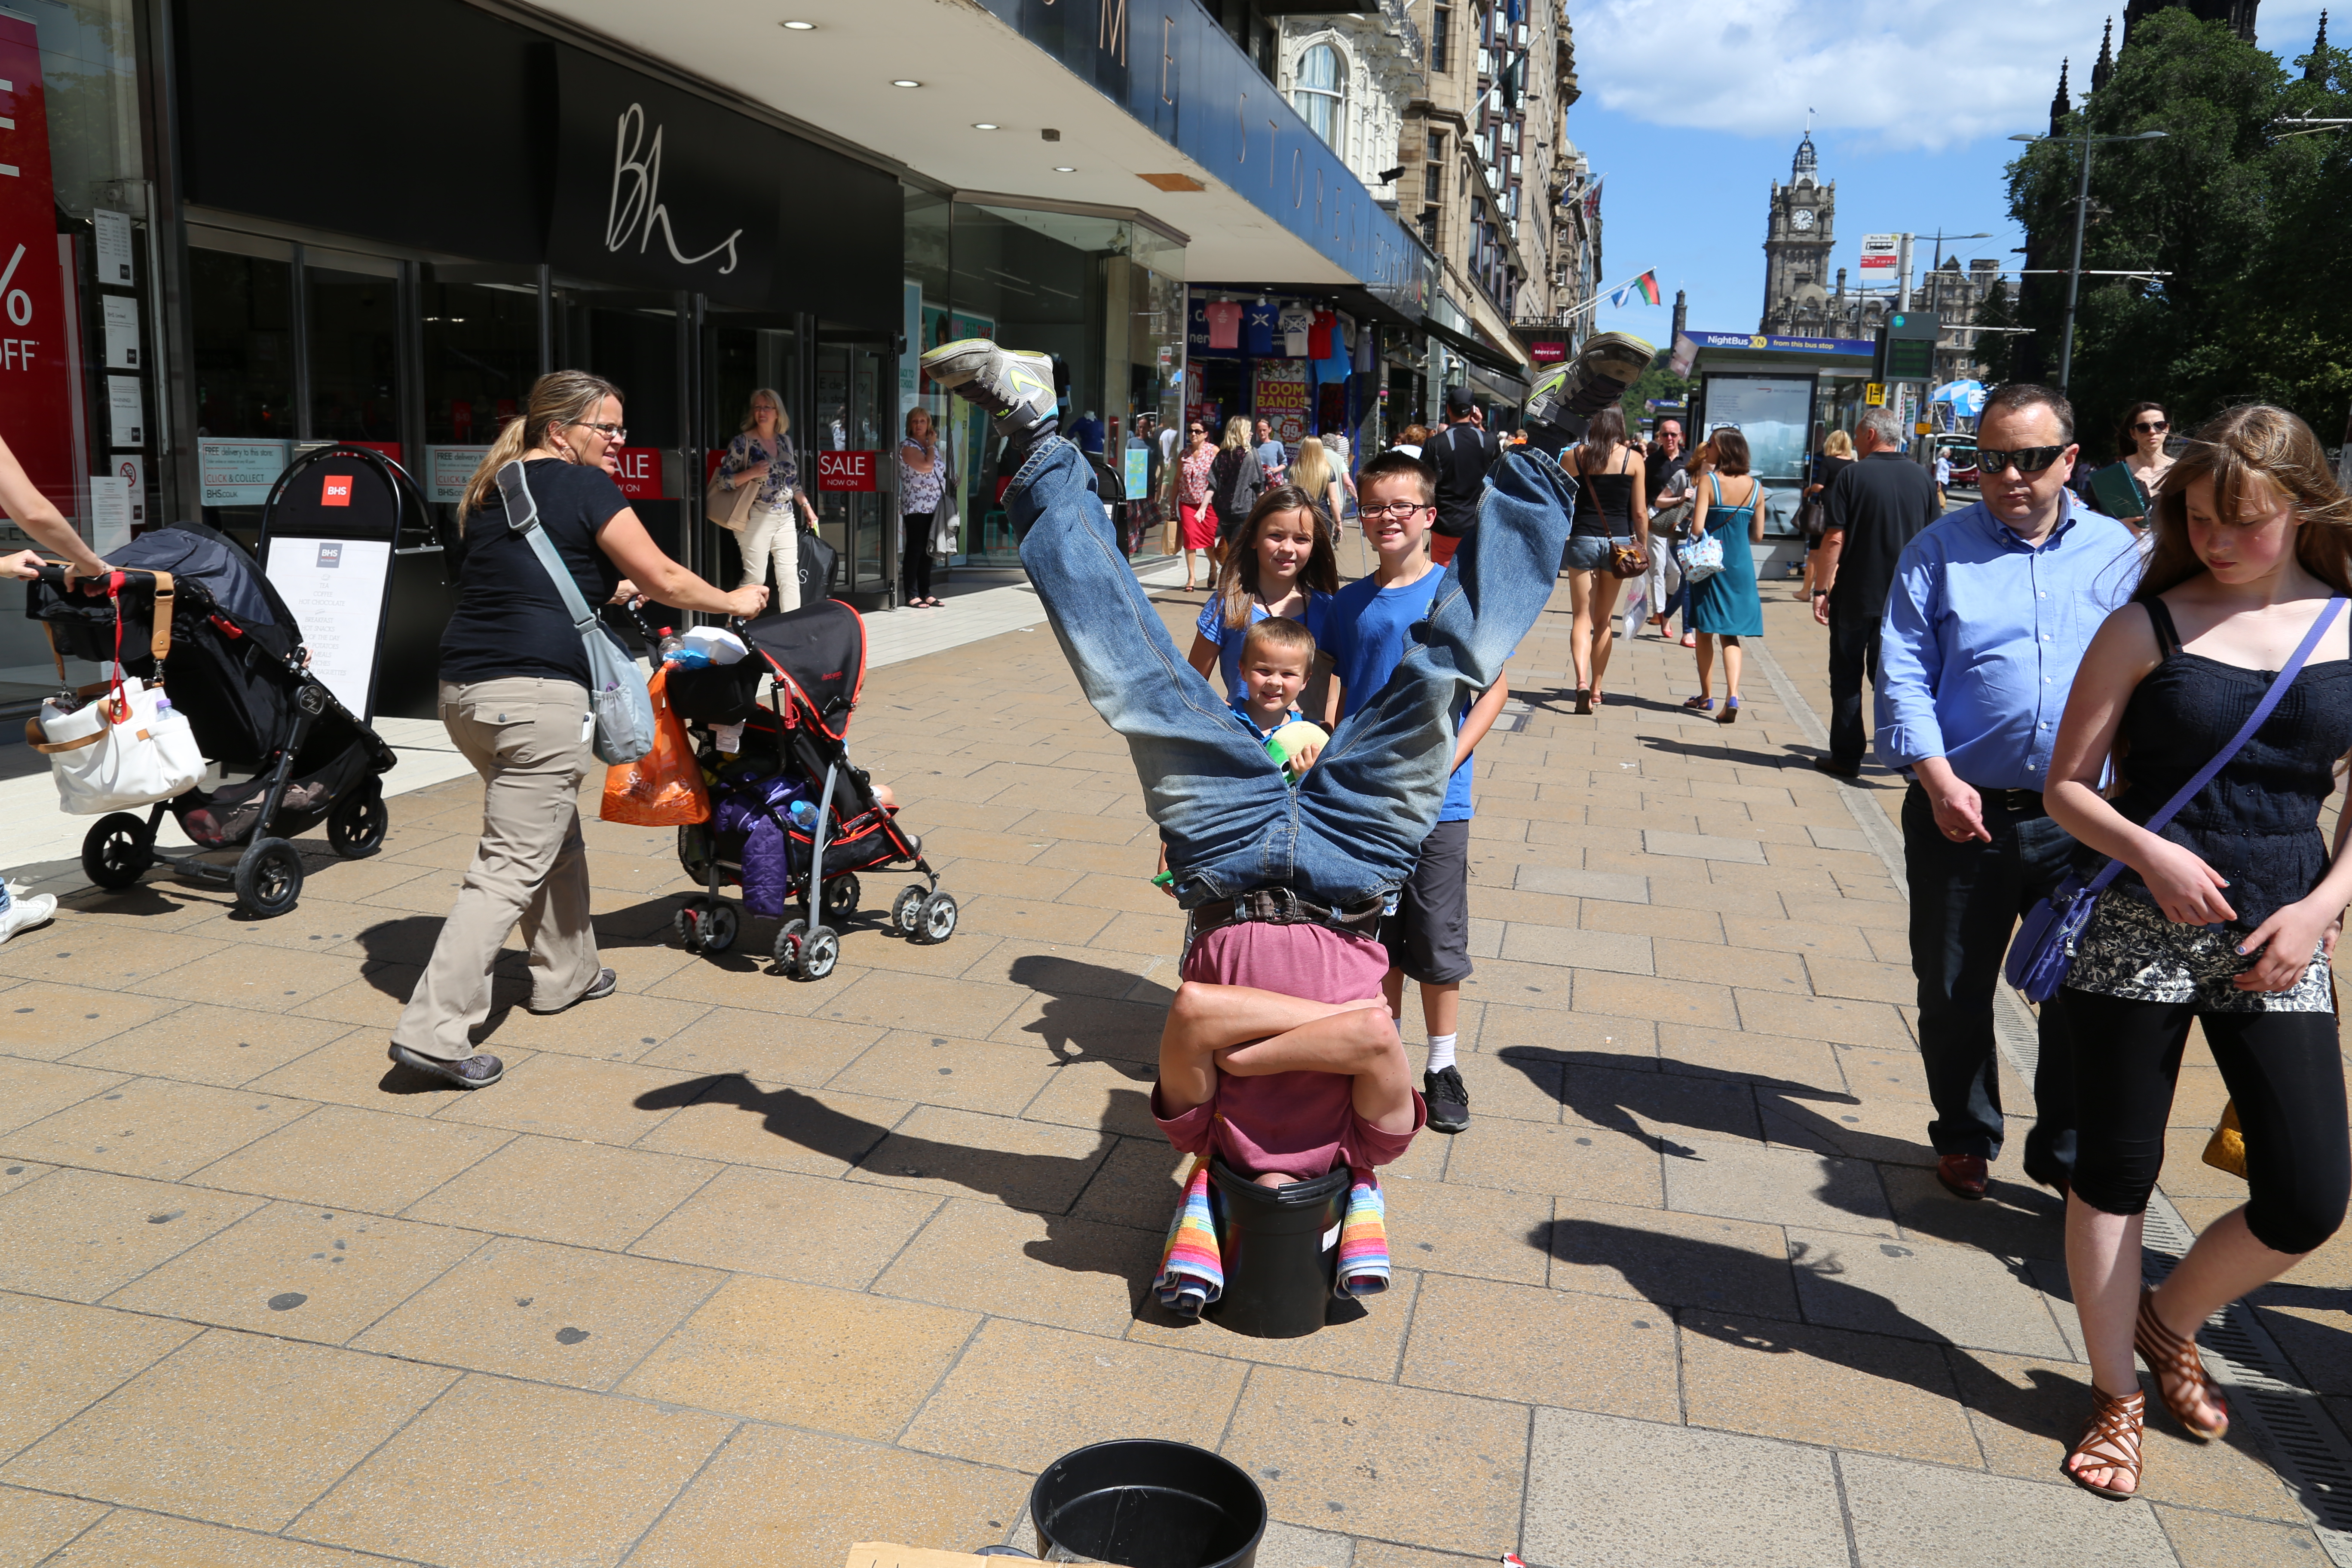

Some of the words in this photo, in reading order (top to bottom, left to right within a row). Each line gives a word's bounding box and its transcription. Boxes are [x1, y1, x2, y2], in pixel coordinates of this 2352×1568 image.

[605, 103, 742, 274] Bhs
[1708, 336, 1749, 346] NightBus
[1260, 383, 1305, 395] LOOM
[1257, 396, 1305, 408] BANDS
[205, 447, 219, 456] FREE
[221, 447, 242, 458] delivery
[250, 447, 258, 456] this
[454, 453, 477, 462] delivery
[614, 455, 649, 478] ALE
[820, 455, 865, 476] SALE
[206, 474, 227, 483] CLICK
[235, 474, 264, 482] COLLECT
[328, 486, 346, 495] BHS
[626, 772, 688, 794] Sainsury's
[671, 798, 688, 807] less
